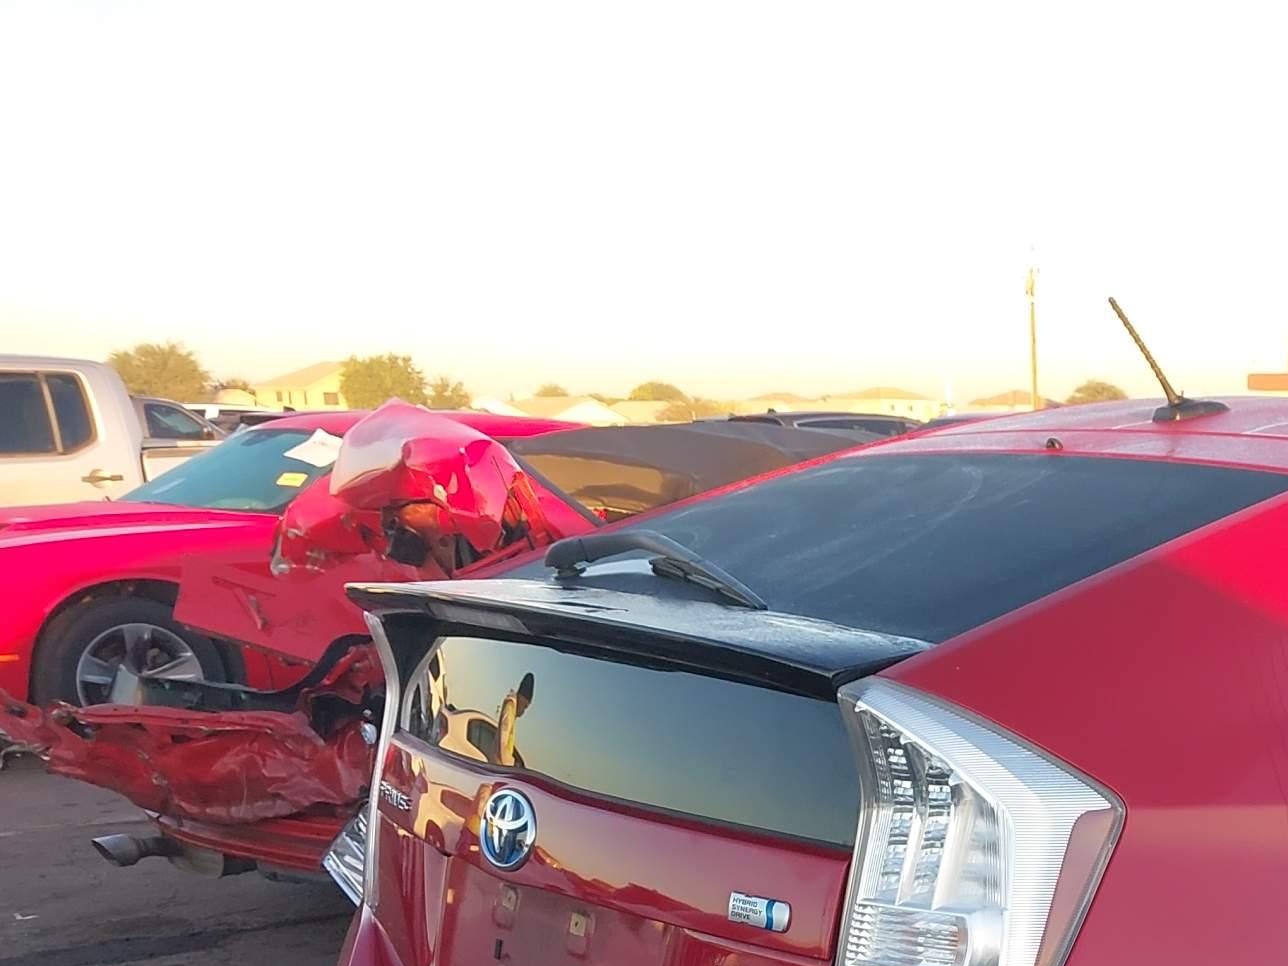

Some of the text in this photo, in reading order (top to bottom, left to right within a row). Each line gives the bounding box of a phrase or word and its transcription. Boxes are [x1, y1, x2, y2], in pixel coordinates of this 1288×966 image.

[732, 897, 758, 908] HYBRID
[730, 911, 750, 920] DRIVE
[731, 904, 763, 916] SYNERGY
